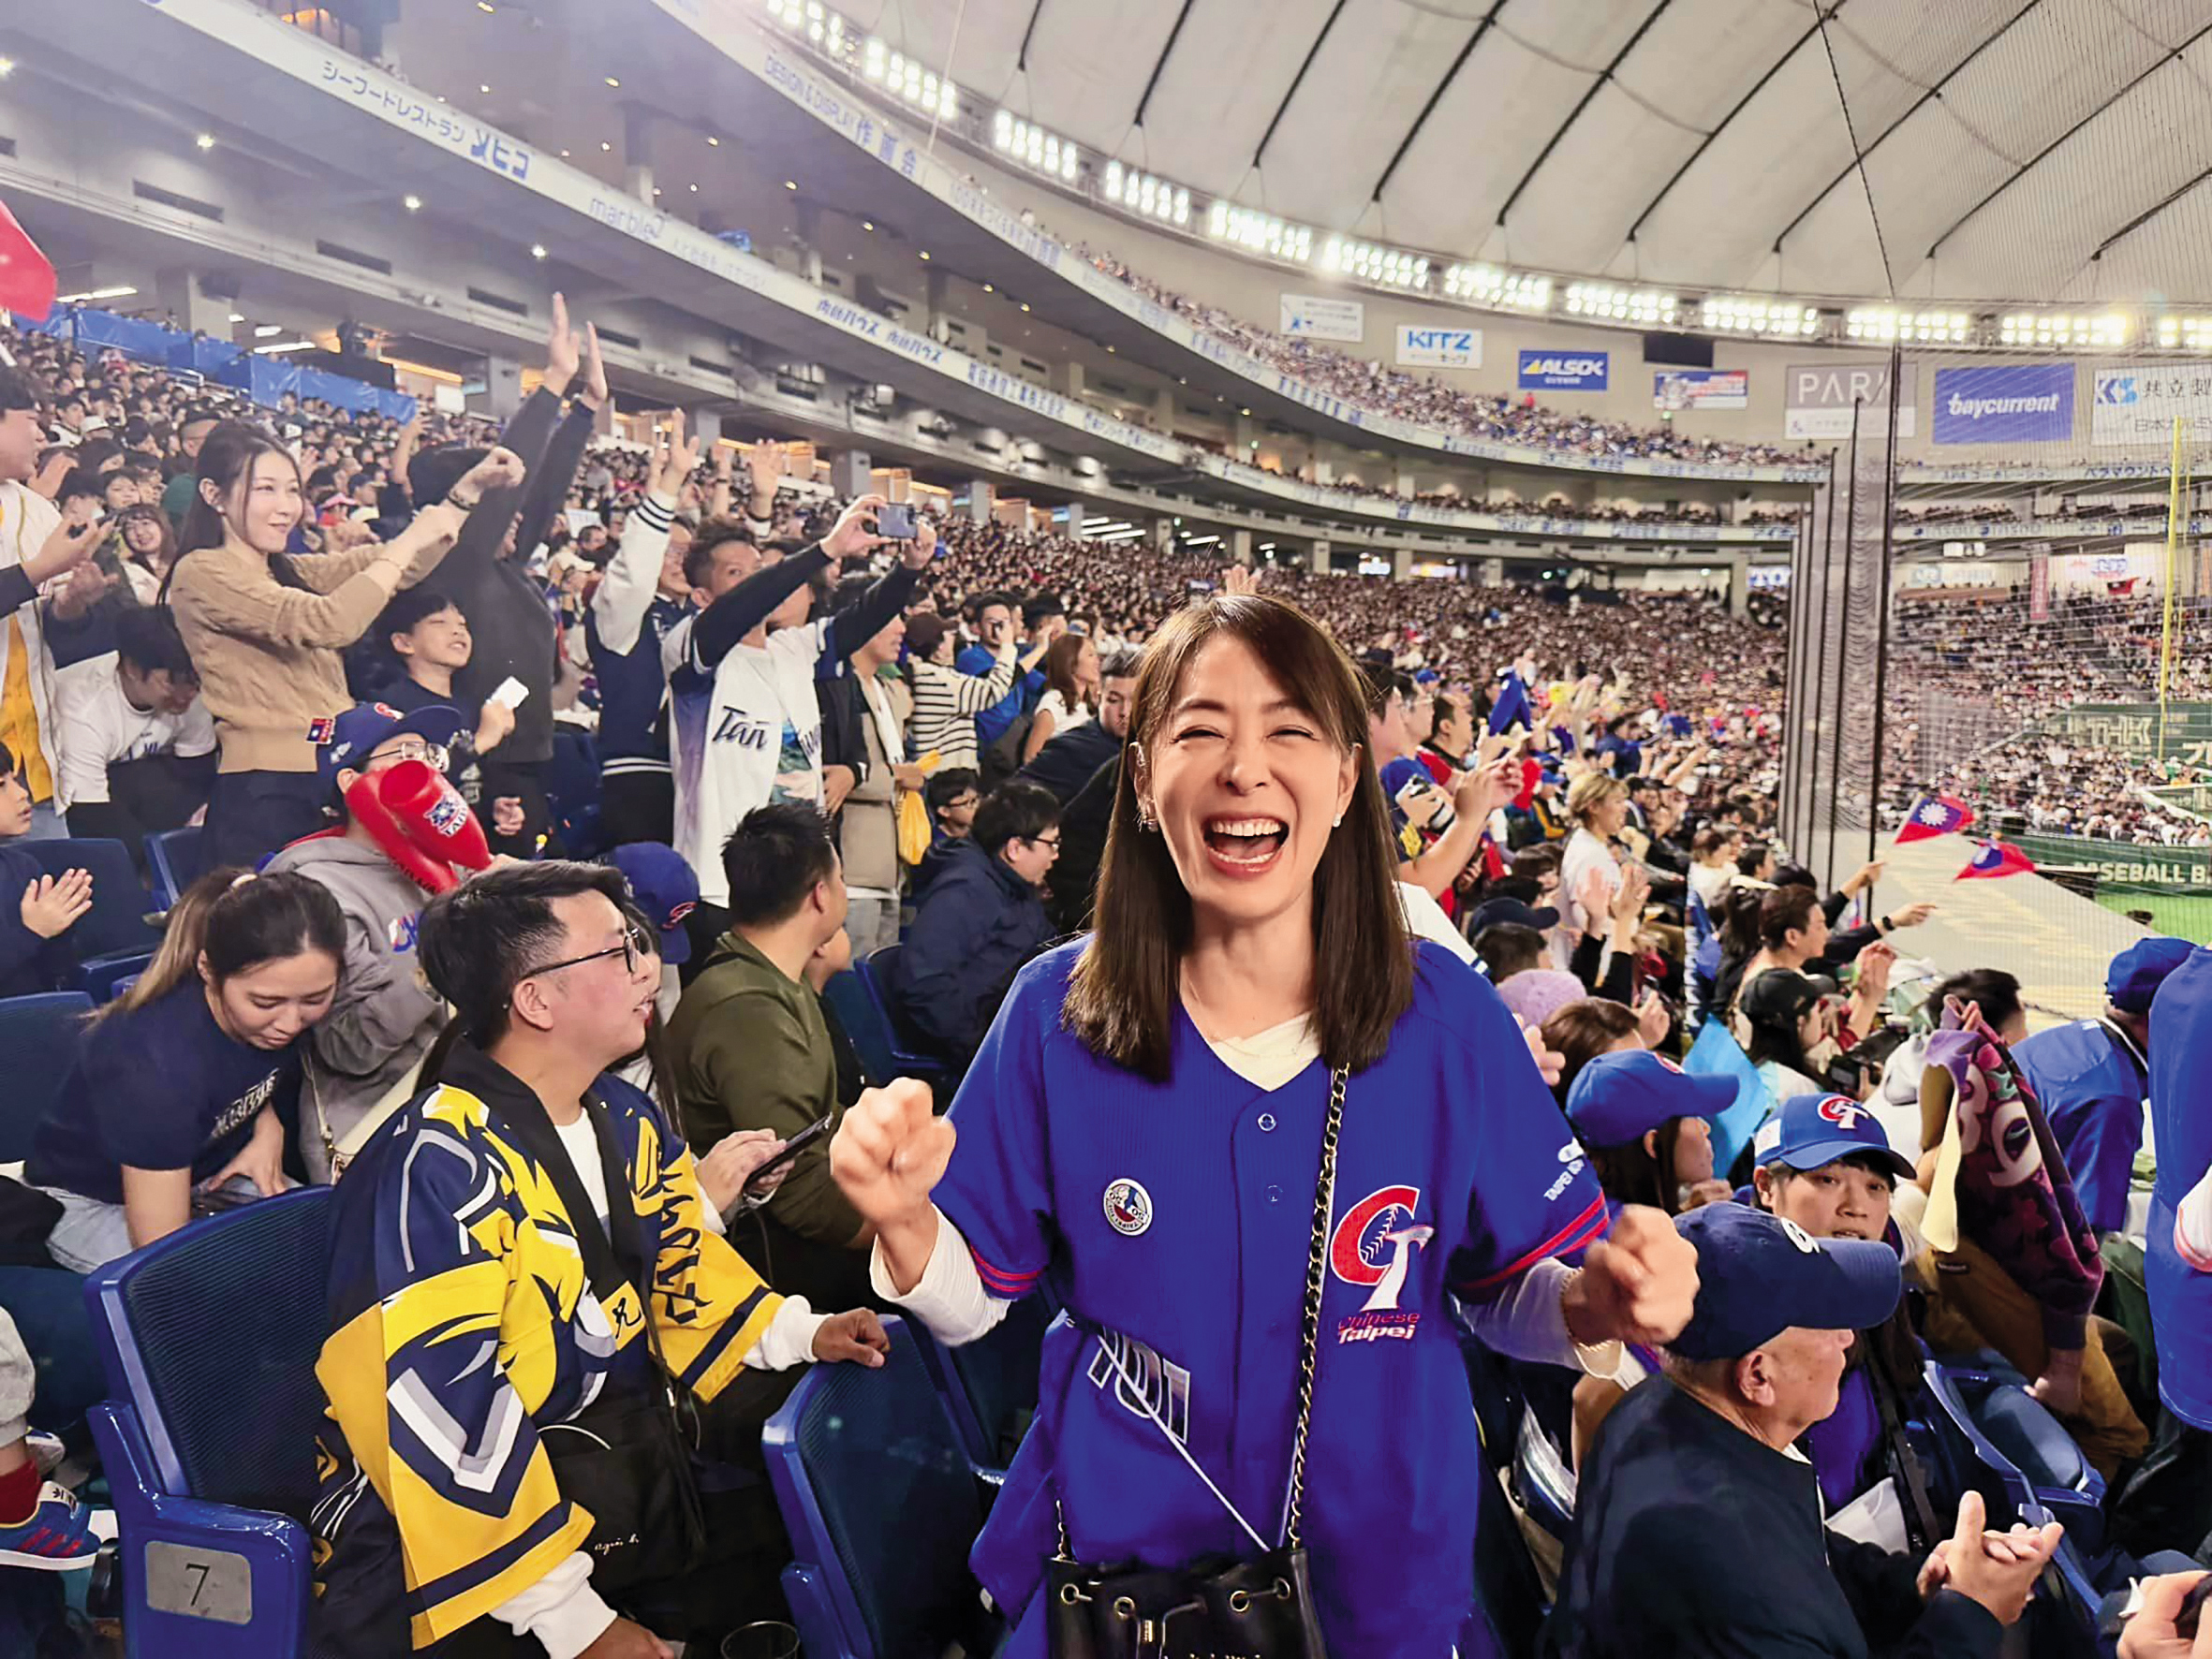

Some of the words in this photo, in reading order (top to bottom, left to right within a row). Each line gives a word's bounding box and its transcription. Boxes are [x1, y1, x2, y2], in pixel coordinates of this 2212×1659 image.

[323, 61, 465, 142] シーフードレストラン
[1408, 330, 1471, 350] KITZ
[1539, 358, 1605, 376] ALSOK
[1948, 392, 2059, 419] baycurrent
[2086, 714, 2153, 746] THK
[1337, 1324, 1416, 1345] Taipei
[185, 1562, 211, 1608] 7
